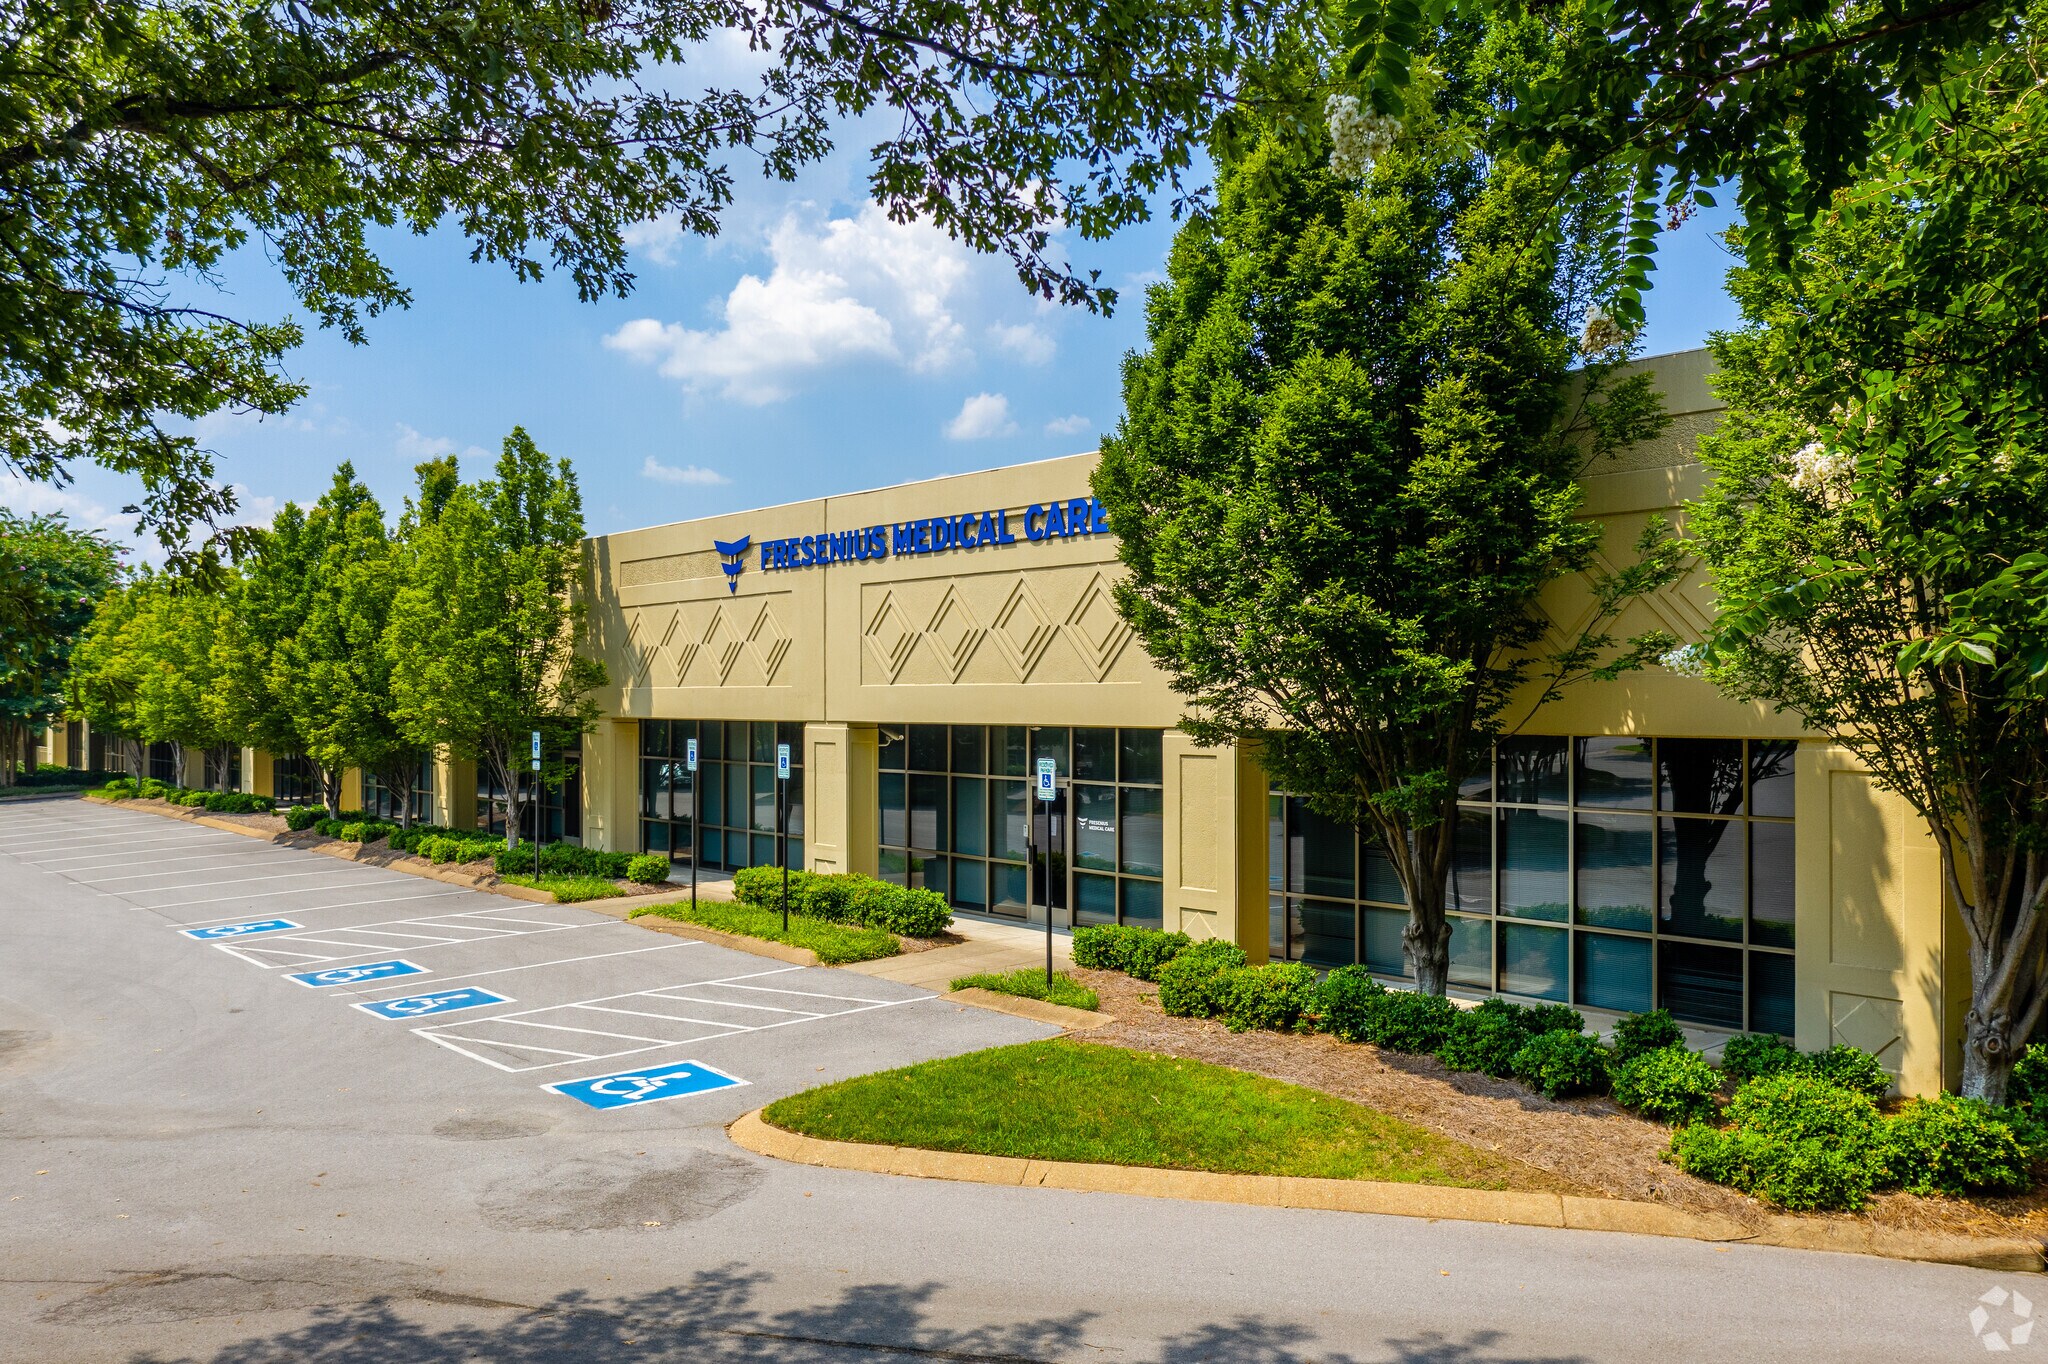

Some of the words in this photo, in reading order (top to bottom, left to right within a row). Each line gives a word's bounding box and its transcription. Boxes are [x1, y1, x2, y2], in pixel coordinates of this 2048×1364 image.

[761, 525, 887, 571] FRESENIUS
[892, 508, 1015, 556] MEDICAL
[1024, 496, 1109, 542] CARE
